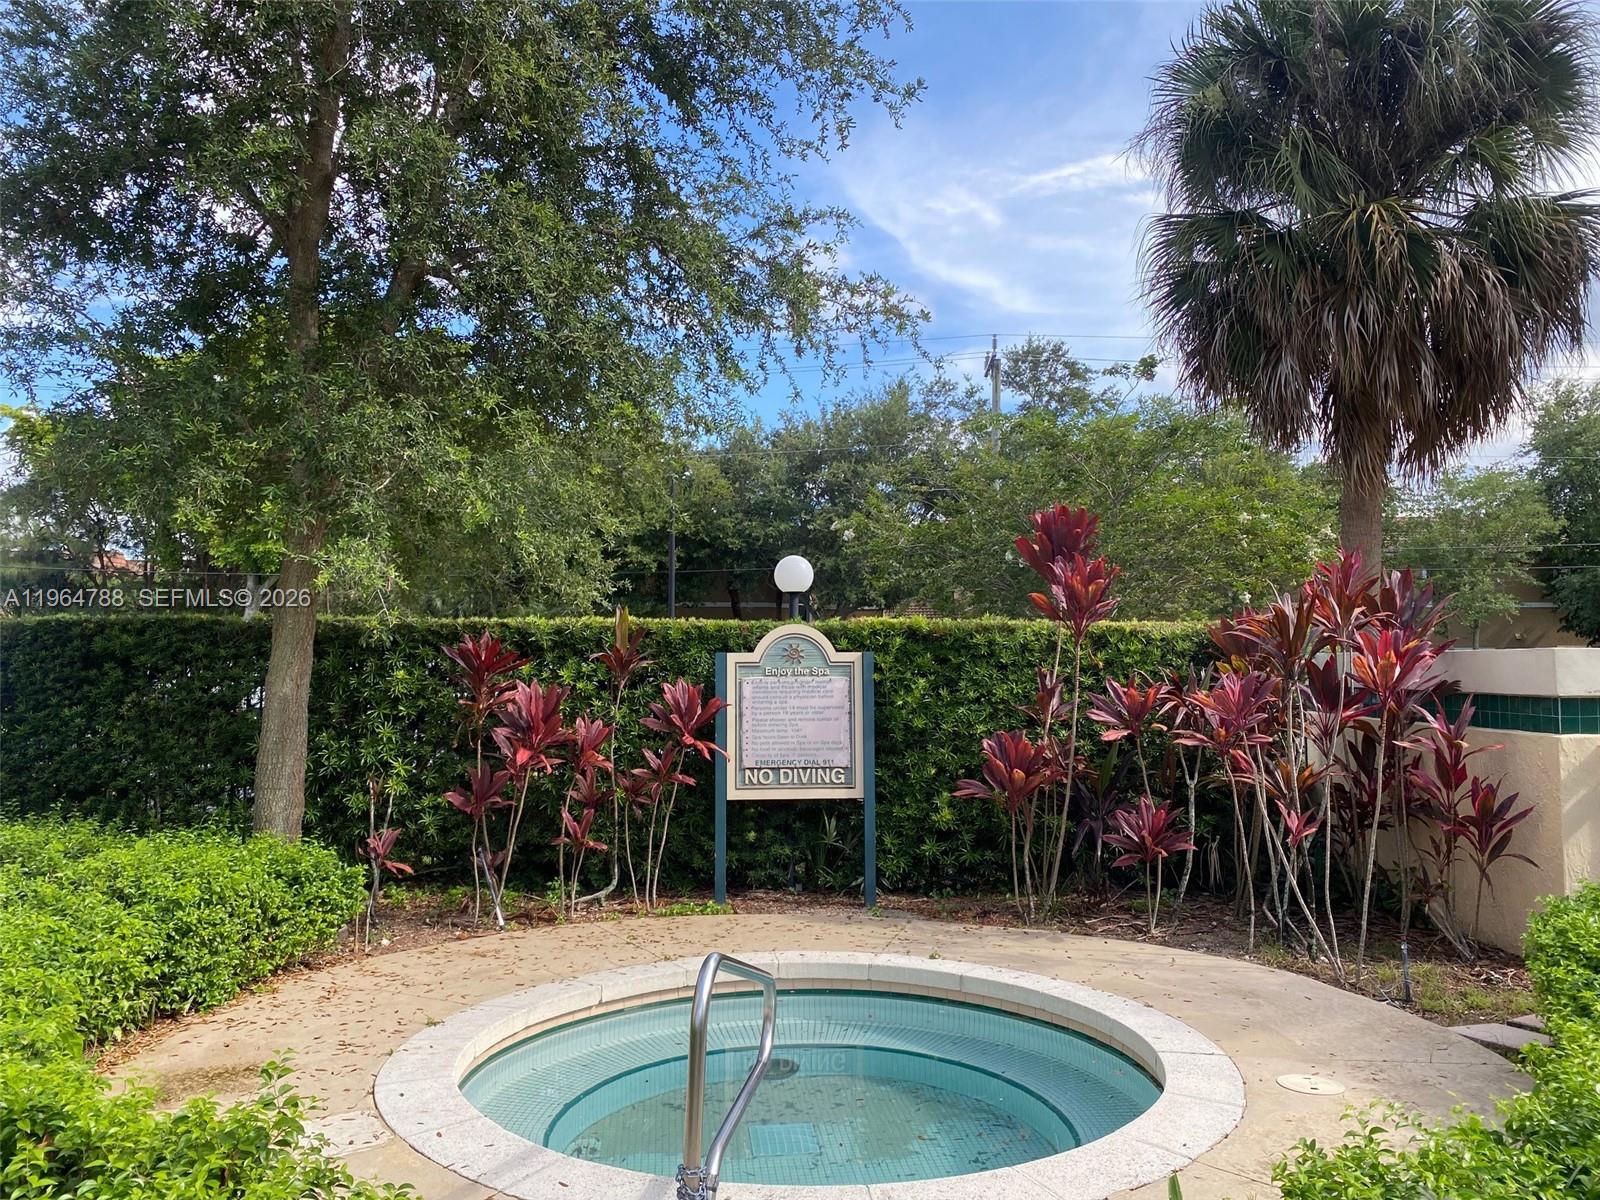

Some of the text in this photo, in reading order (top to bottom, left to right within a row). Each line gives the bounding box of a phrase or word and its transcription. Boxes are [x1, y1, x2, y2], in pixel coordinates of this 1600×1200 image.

[765, 667, 830, 677] Enjoy the Spa
[745, 768, 845, 785] NO DIVING
